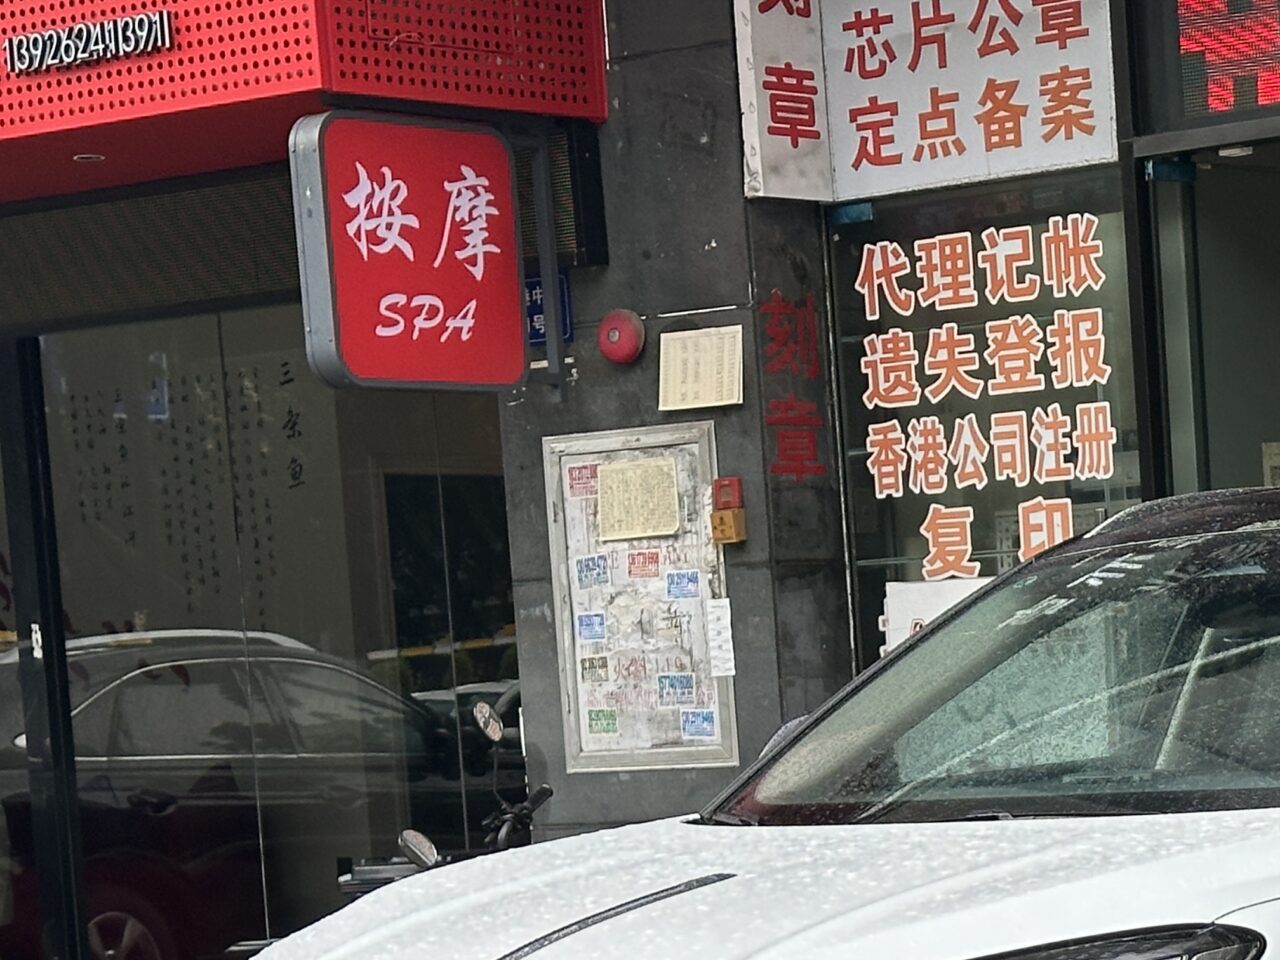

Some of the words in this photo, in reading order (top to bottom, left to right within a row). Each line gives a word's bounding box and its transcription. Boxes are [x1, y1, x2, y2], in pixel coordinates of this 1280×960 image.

[758, 0, 821, 149] 章
[842, 0, 1090, 80] 芯片公章
[848, 65, 1096, 171] 定点备案
[341, 161, 501, 282] 按摩
[854, 213, 1106, 320] 代理记帐
[374, 292, 480, 342] SPA
[861, 308, 1112, 409] 遗失登报
[759, 289, 827, 482] 刻章
[866, 401, 1117, 499] 香港公司注册
[920, 496, 1074, 581] 复印
